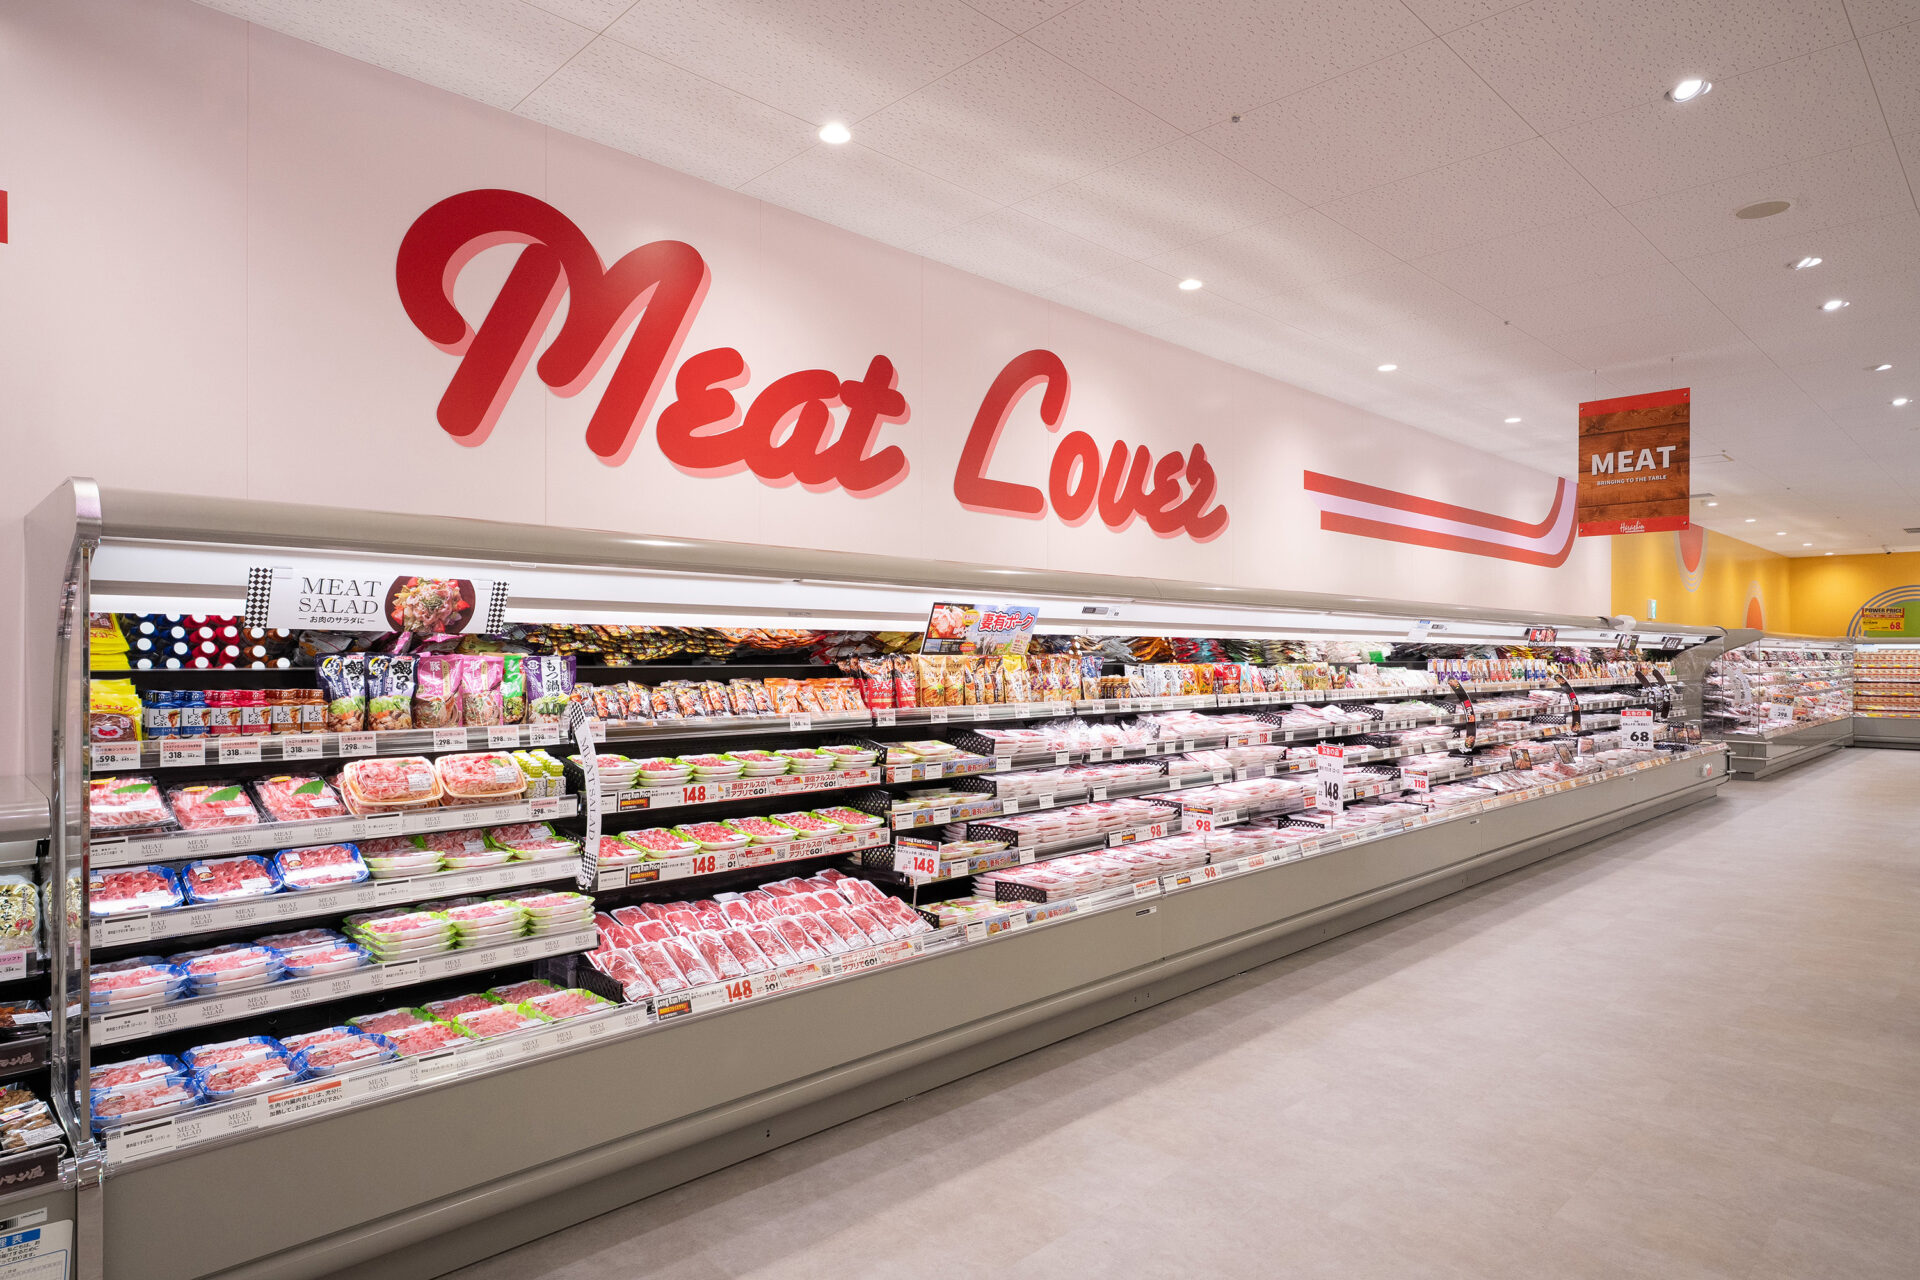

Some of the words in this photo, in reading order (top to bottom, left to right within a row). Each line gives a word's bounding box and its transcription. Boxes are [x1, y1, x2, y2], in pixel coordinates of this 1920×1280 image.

[396, 189, 909, 498] Meat
[954, 350, 1229, 543] Lover
[1592, 446, 1676, 475] MEAT
[301, 577, 381, 597] MEAT
[298, 598, 378, 615] SALAD
[310, 616, 365, 624] お肉のサラダに
[979, 610, 1035, 632] 妻有ポーク
[1260, 733, 1268, 743] 118
[1630, 732, 1649, 742] 68
[580, 736, 596, 790] MEAT
[732, 781, 766, 790] 原信ナルスの
[804, 781, 836, 789] アプリでGO!
[1414, 779, 1426, 788] 118
[683, 786, 705, 804] 148
[730, 788, 766, 797] アプリでGO!
[1324, 781, 1338, 800] 148
[1151, 825, 1161, 837] 98
[1196, 820, 1210, 832] 98
[790, 848, 822, 856] アプリでGO!
[692, 856, 715, 874] 148
[914, 857, 934, 874] 148
[1205, 867, 1216, 878] 98
[842, 957, 877, 972] アプリでGO!
[725, 980, 752, 1002] 148
[202, 1004, 223, 1012] MEAT
[154, 1013, 176, 1021] MEAT
[154, 1019, 177, 1027] SALAD
[368, 1077, 387, 1086] MEAT
[369, 1082, 388, 1090] SALAD
[228, 1111, 251, 1120] MEAT
[229, 1116, 251, 1126] SALAD
[177, 1123, 200, 1133] MEAT
[177, 1129, 201, 1138] SALAD
